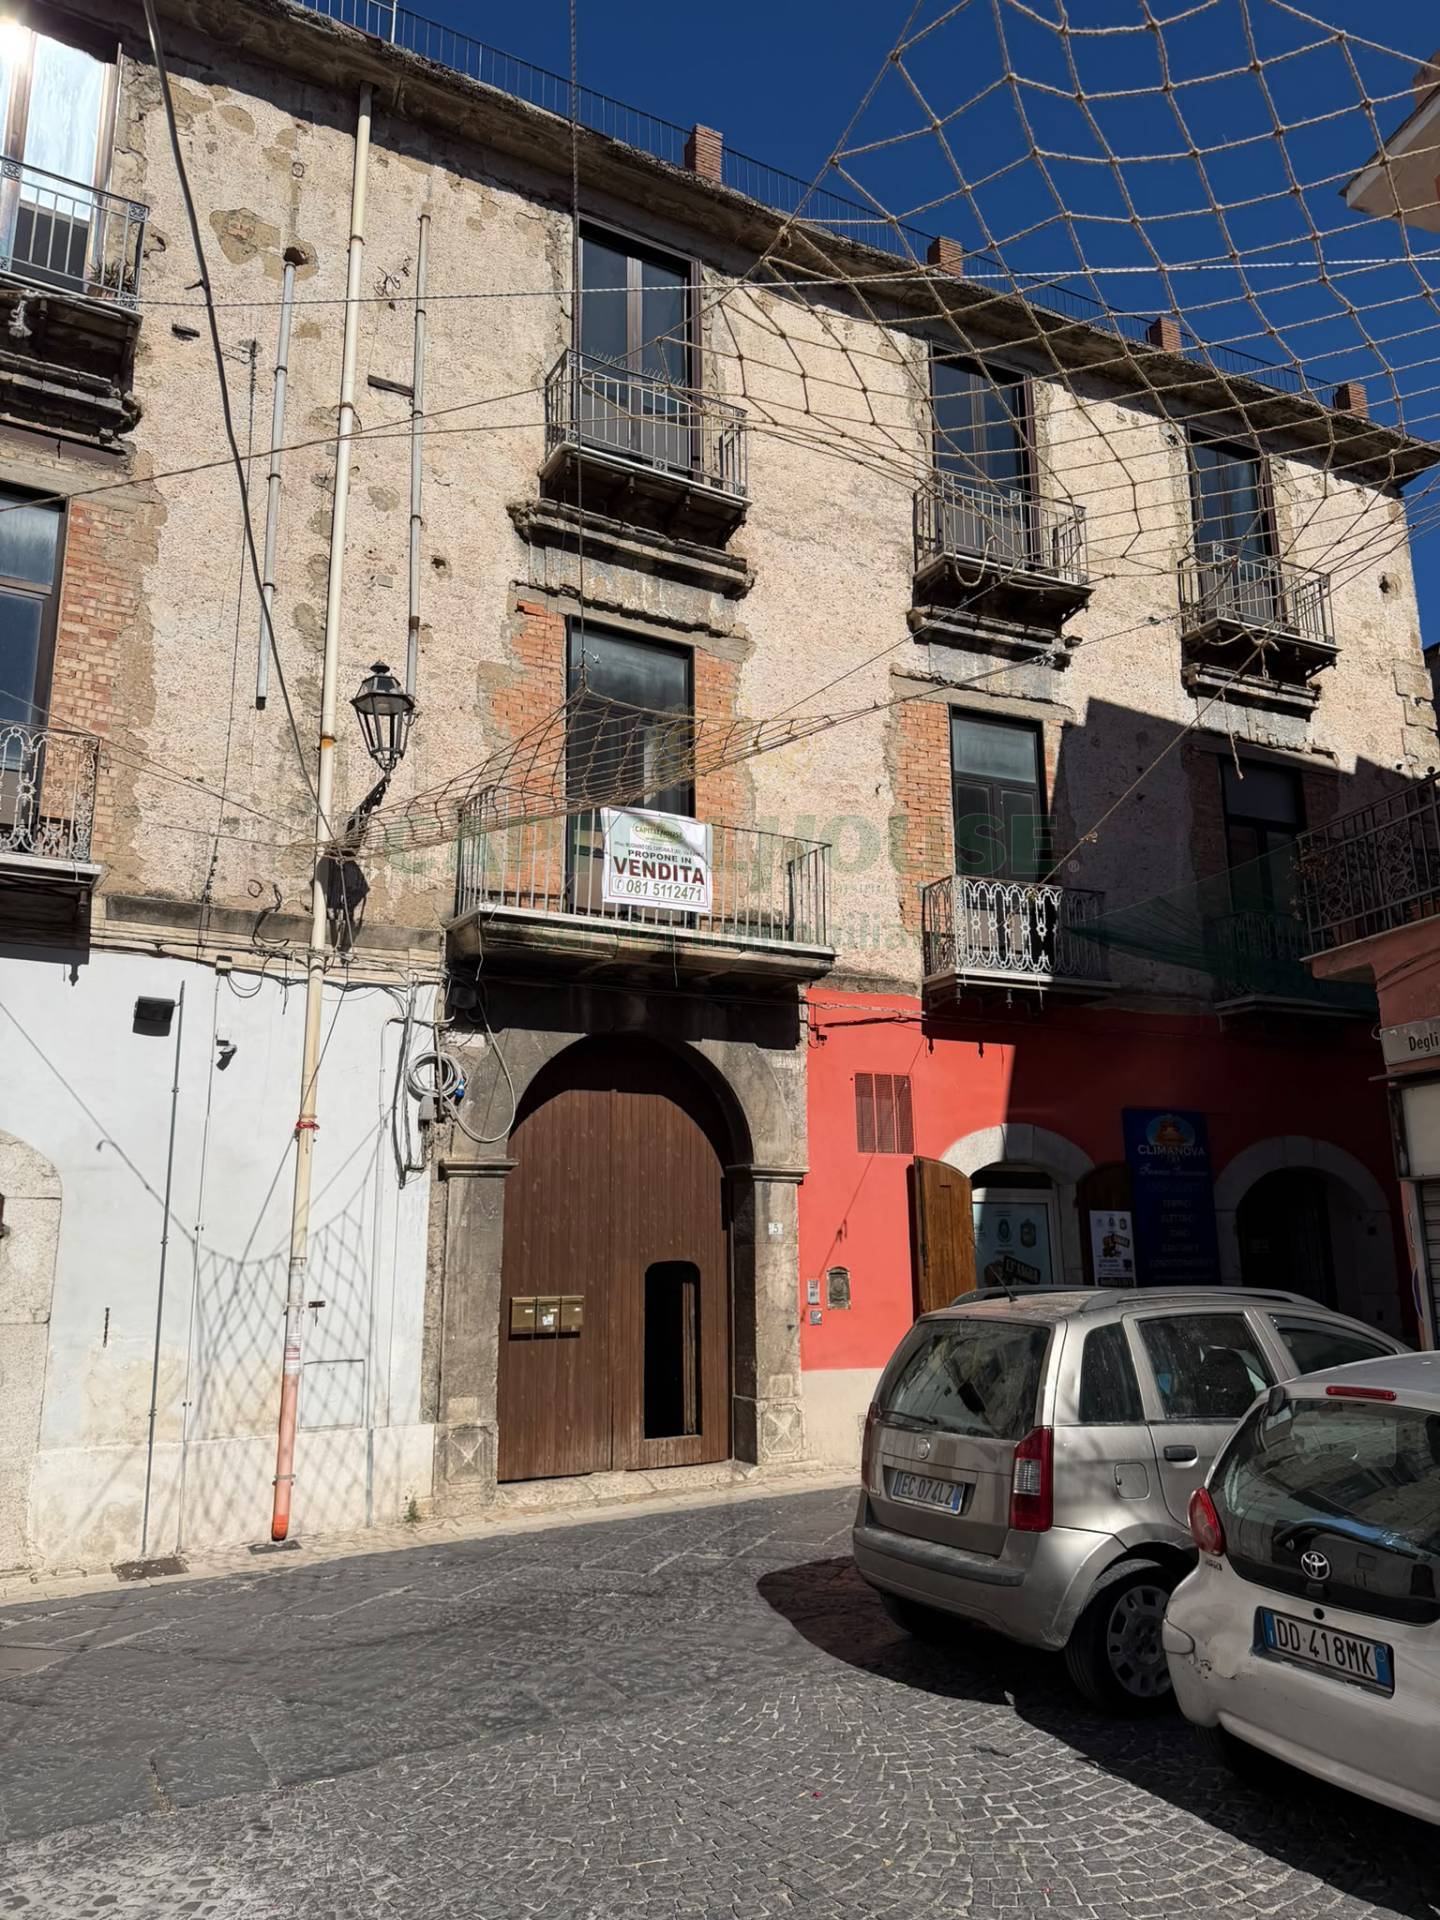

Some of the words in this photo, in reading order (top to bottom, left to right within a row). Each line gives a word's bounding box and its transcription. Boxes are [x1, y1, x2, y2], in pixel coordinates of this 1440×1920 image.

[628, 850, 678, 862] PROPONE
[613, 855, 705, 886] VENDITA
[626, 879, 648, 895] 081
[653, 883, 701, 901] 5112471
[1408, 1032, 1439, 1052] Degli
[1137, 1144, 1205, 1157] CLIMANOVA
[773, 1223, 779, 1233] 5
[901, 1475, 916, 1497] EC
[1276, 1617, 1300, 1651] DD
[1309, 1629, 1376, 1677] 418MK
